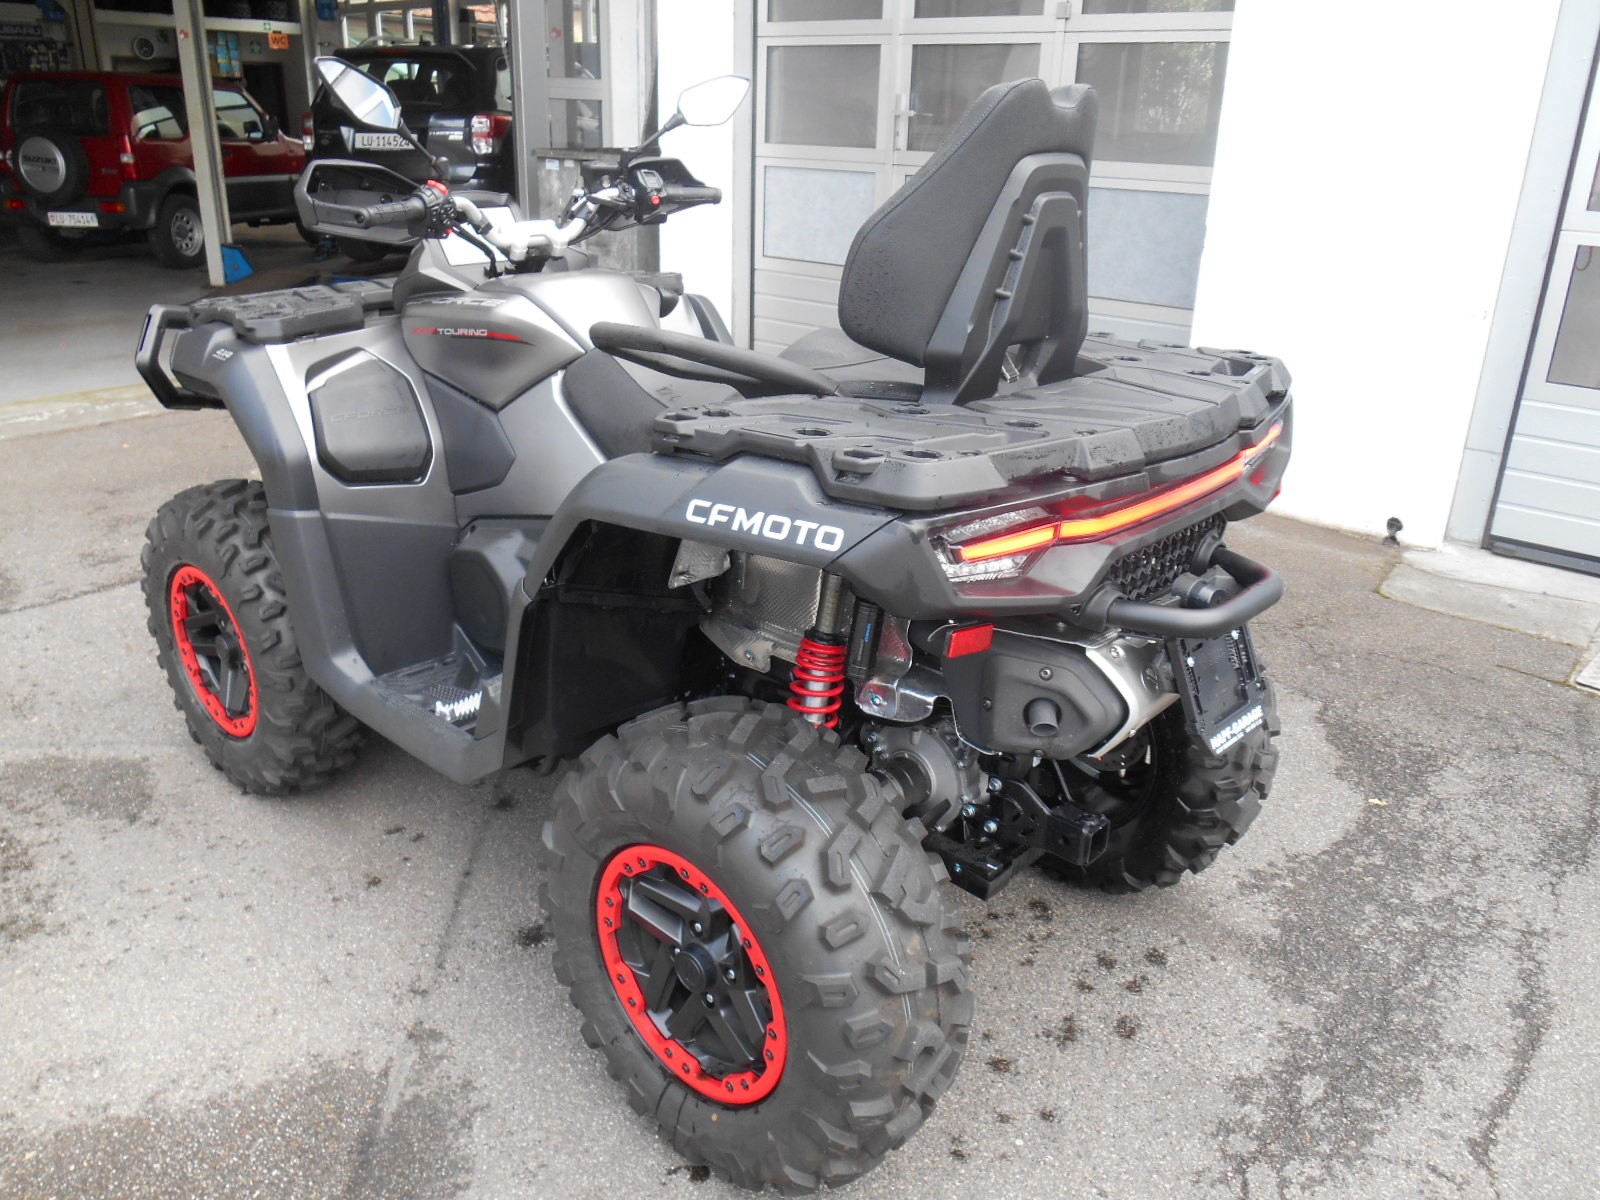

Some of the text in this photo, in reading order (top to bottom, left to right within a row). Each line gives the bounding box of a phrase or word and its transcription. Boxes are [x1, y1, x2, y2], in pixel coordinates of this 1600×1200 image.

[270, 35, 287, 46] WC
[22, 155, 57, 165] SUZUKI
[437, 327, 489, 337] TOURING
[685, 498, 845, 552] CFMOTO
